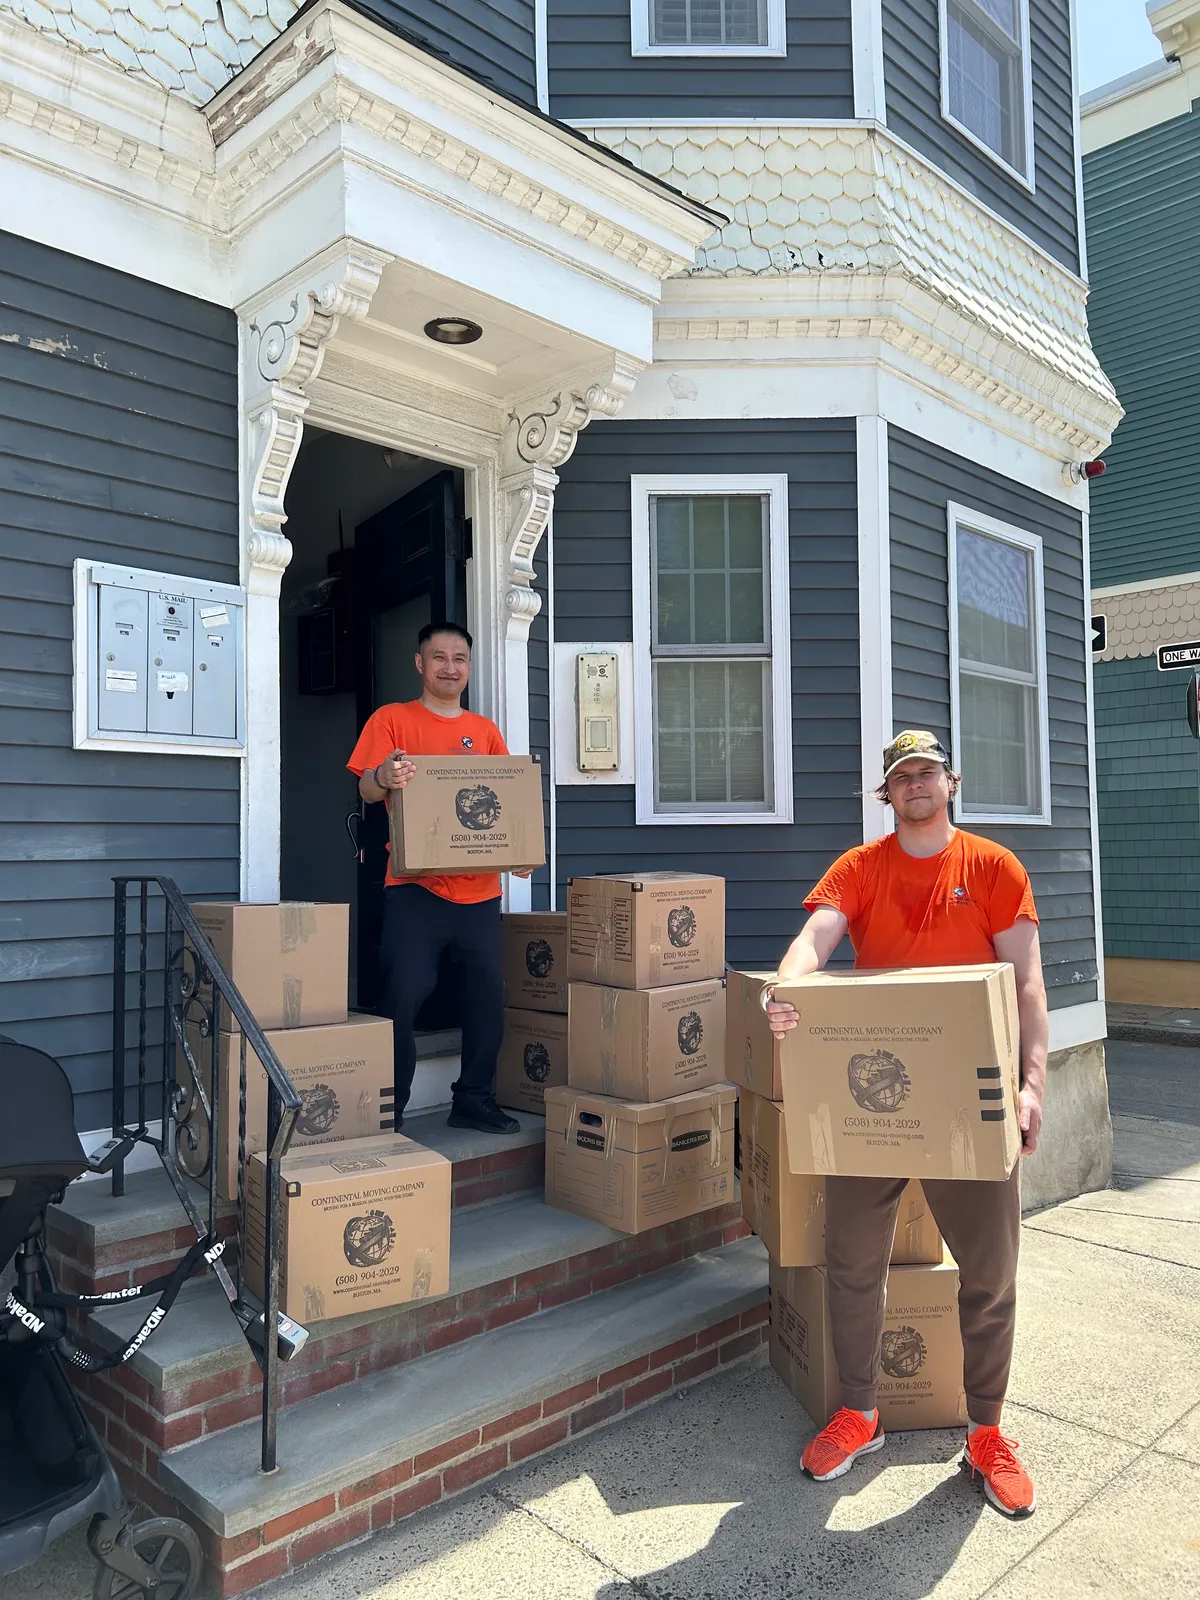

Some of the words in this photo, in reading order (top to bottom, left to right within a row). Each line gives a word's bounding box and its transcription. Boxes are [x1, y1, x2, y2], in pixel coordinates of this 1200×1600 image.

[171, 596, 188, 604] MAIL
[1165, 650, 1186, 662] ONE
[1189, 649, 1200, 659] W
[451, 833, 471, 843] (508)
[472, 833, 507, 842] 904-2029
[650, 890, 677, 899] CONTINENTAL
[808, 1026, 865, 1035] CONTINENTAL
[865, 1026, 900, 1035] MOVING
[901, 1026, 944, 1035] COMPANY
[261, 1067, 308, 1080] CENTAL
[308, 1063, 335, 1074] MOVING
[335, 1059, 367, 1069] COMPANY
[844, 1116, 870, 1128] (508)
[872, 1117, 921, 1129] 904-2029
[671, 1136, 698, 1148] BANKERS
[697, 1133, 709, 1142] BOX
[842, 1131, 925, 1141] www.continental-moving.com
[595, 1139, 605, 1147] BO
[311, 1192, 362, 1207] CONTINENTAL
[362, 1186, 391, 1199] MOVING
[391, 1181, 425, 1193] COMPANY
[203, 1239, 226, 1264] ND
[335, 1273, 358, 1287] (508)
[360, 1265, 400, 1281] 904-2029
[332, 1277, 402, 1295] www.continental-moving.com
[352, 1290, 372, 1299] BOSTON
[895, 1306, 921, 1314] MOVING
[921, 1305, 953, 1313] COMPANY
[121, 1305, 166, 1363] NDakter
[877, 1382, 893, 1391] 508)
[895, 1380, 932, 1390] 904-2029
